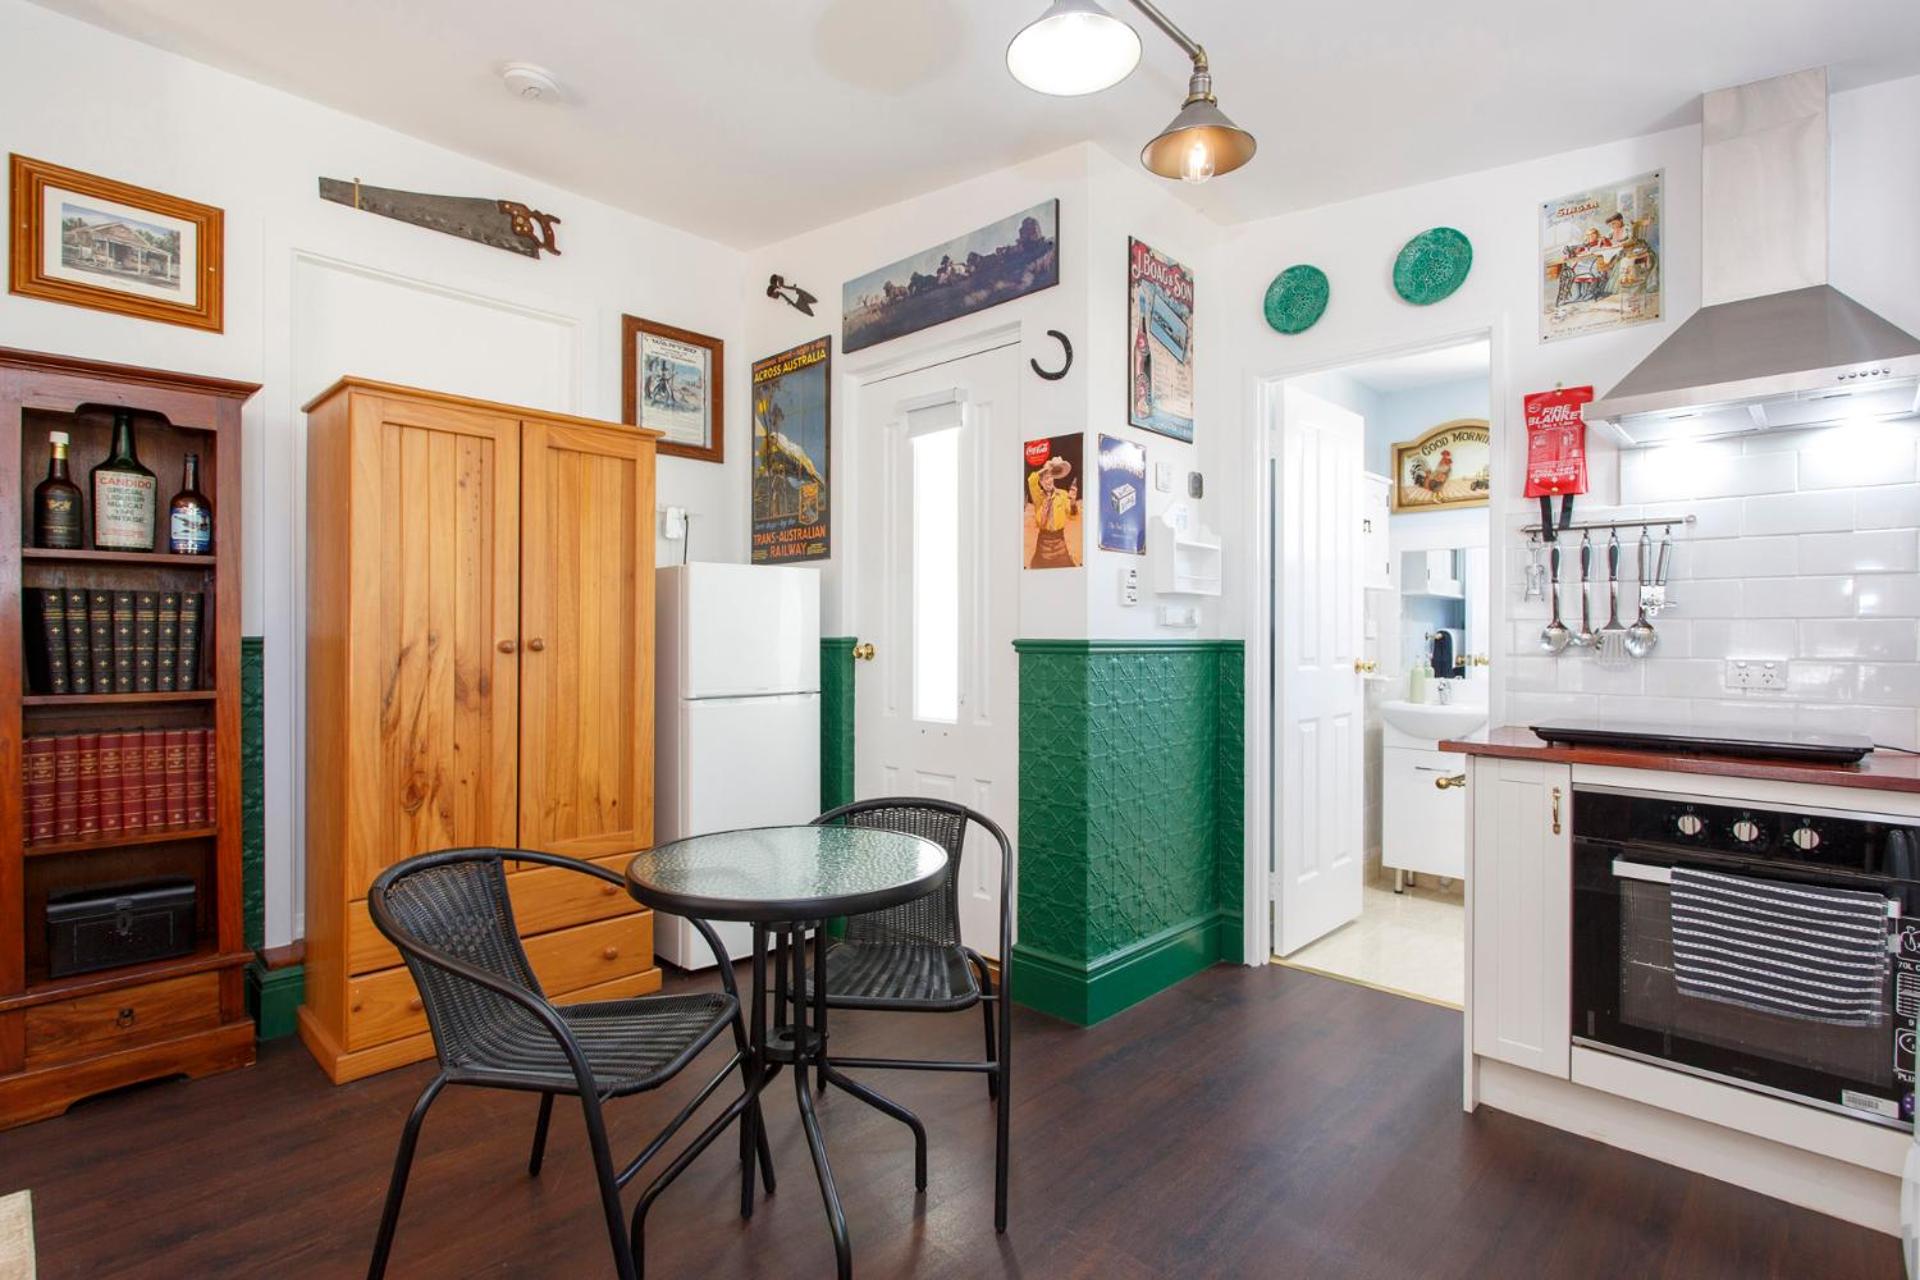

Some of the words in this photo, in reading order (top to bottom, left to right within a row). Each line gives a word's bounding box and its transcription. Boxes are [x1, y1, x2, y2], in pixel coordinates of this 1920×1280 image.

[1174, 273, 1192, 303] SON
[754, 363, 781, 384] ACROSS
[783, 348, 826, 373] AUSTRALIA
[1542, 404, 1572, 417] FIRE
[1421, 437, 1449, 457] GOOD
[100, 477, 151, 489] CANDIDO
[770, 543, 807, 559] RAILWAY
